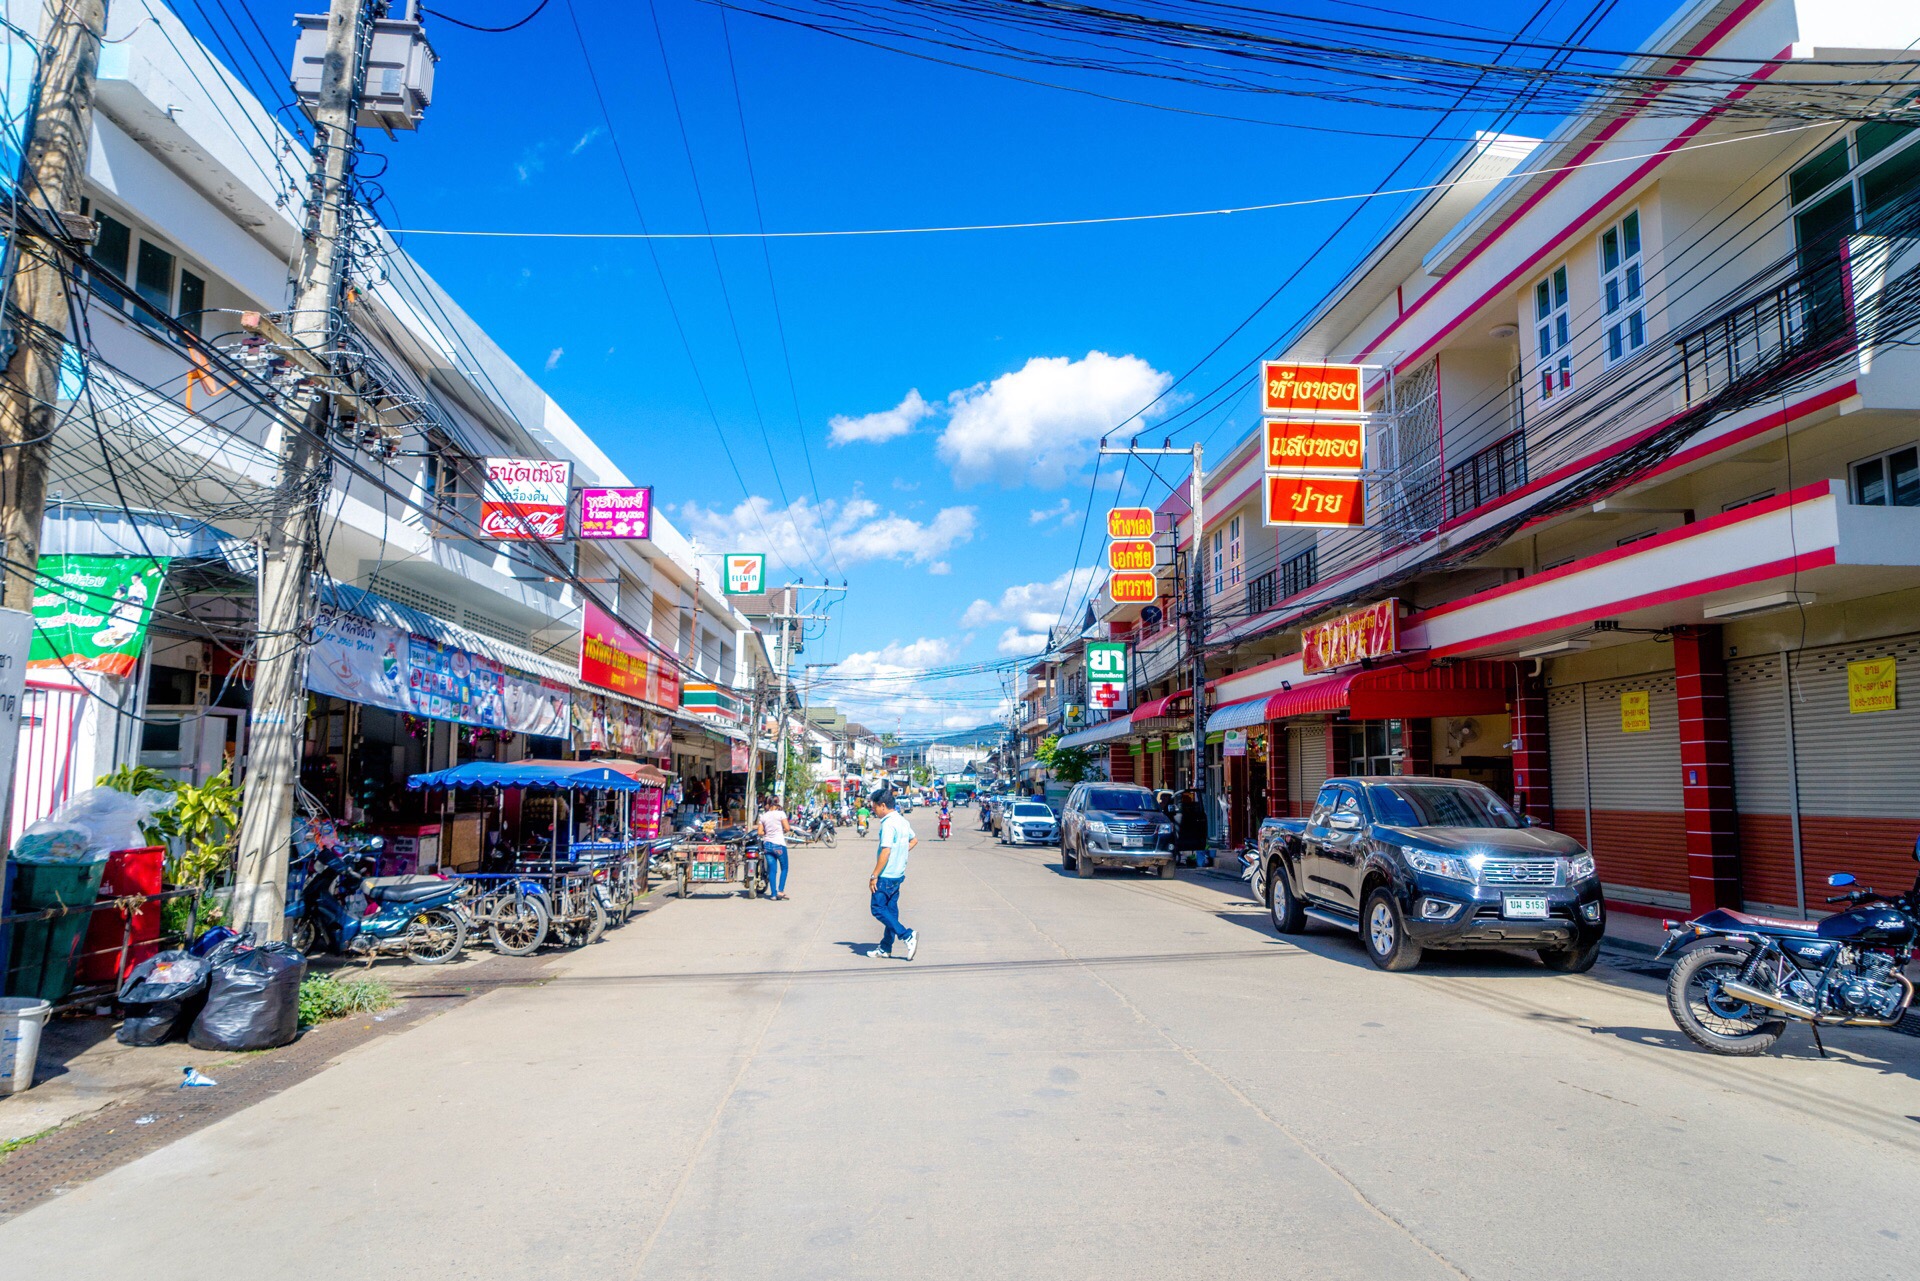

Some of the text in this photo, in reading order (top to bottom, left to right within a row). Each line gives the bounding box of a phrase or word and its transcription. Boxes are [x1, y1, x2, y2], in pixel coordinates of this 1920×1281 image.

[1269, 371, 1357, 401] ห้างทอง
[1271, 434, 1359, 458] แสงทอง
[1290, 486, 1343, 513] ปาย
[1111, 512, 1151, 535] ห้างทอง
[1113, 543, 1151, 568] เอกชัย
[1112, 579, 1153, 597] เยาวราช
[1090, 650, 1125, 670] ยา
[1525, 900, 1545, 910] 5153
